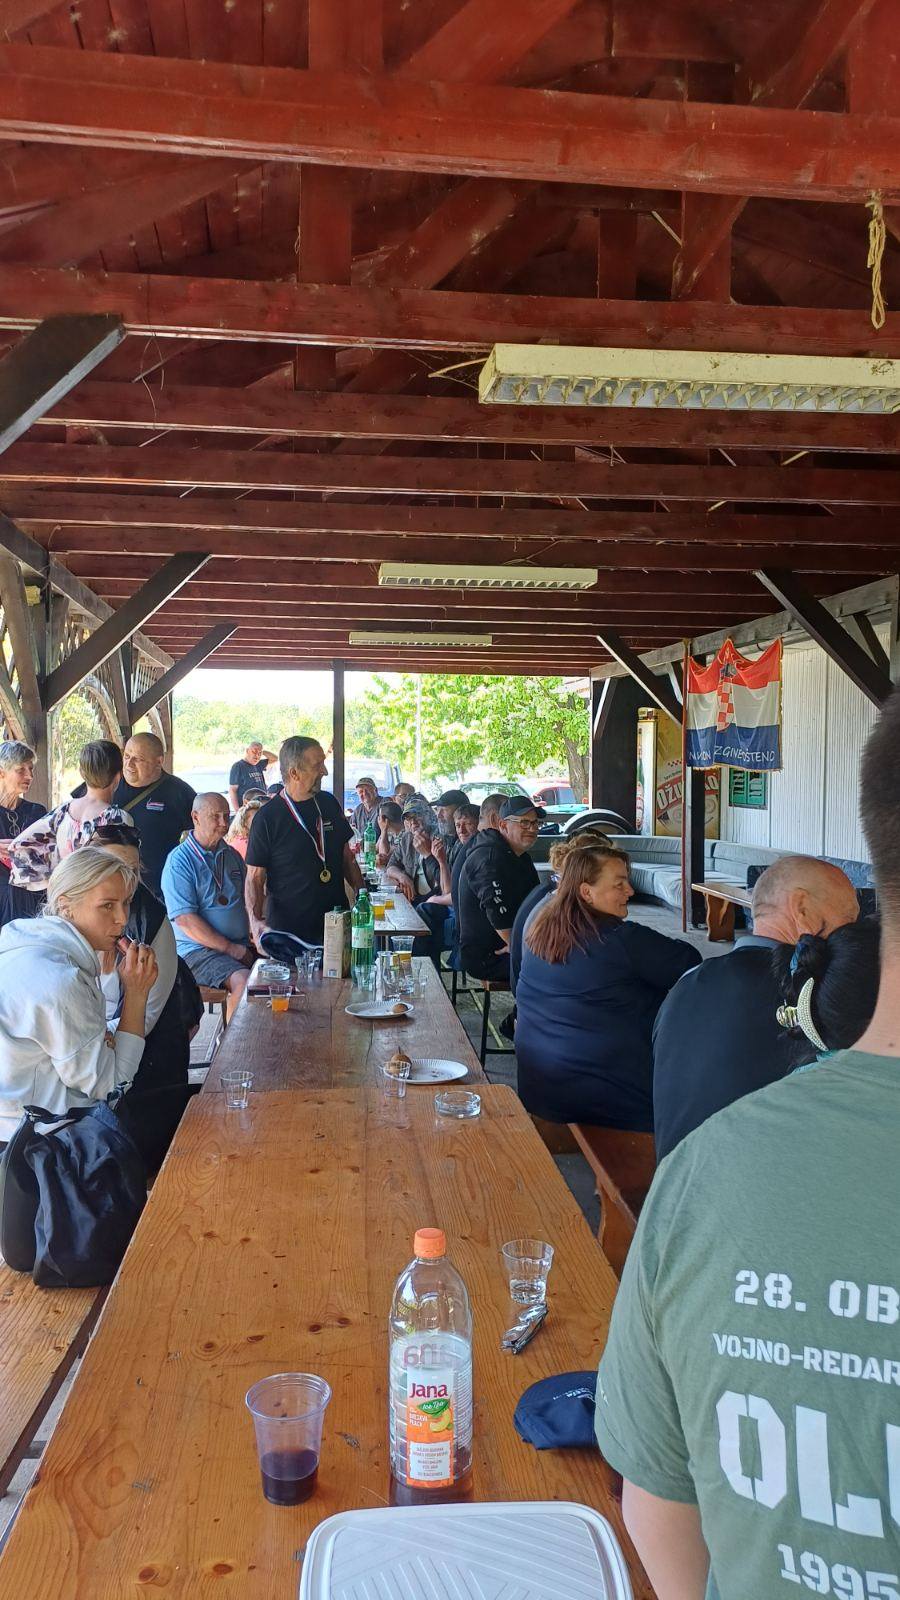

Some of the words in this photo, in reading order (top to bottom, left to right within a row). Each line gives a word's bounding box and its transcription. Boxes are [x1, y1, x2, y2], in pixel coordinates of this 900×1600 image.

[734, 1269, 807, 1312] 28.
[409, 1382, 448, 1398] Jana
[715, 1390, 900, 1538] OL
